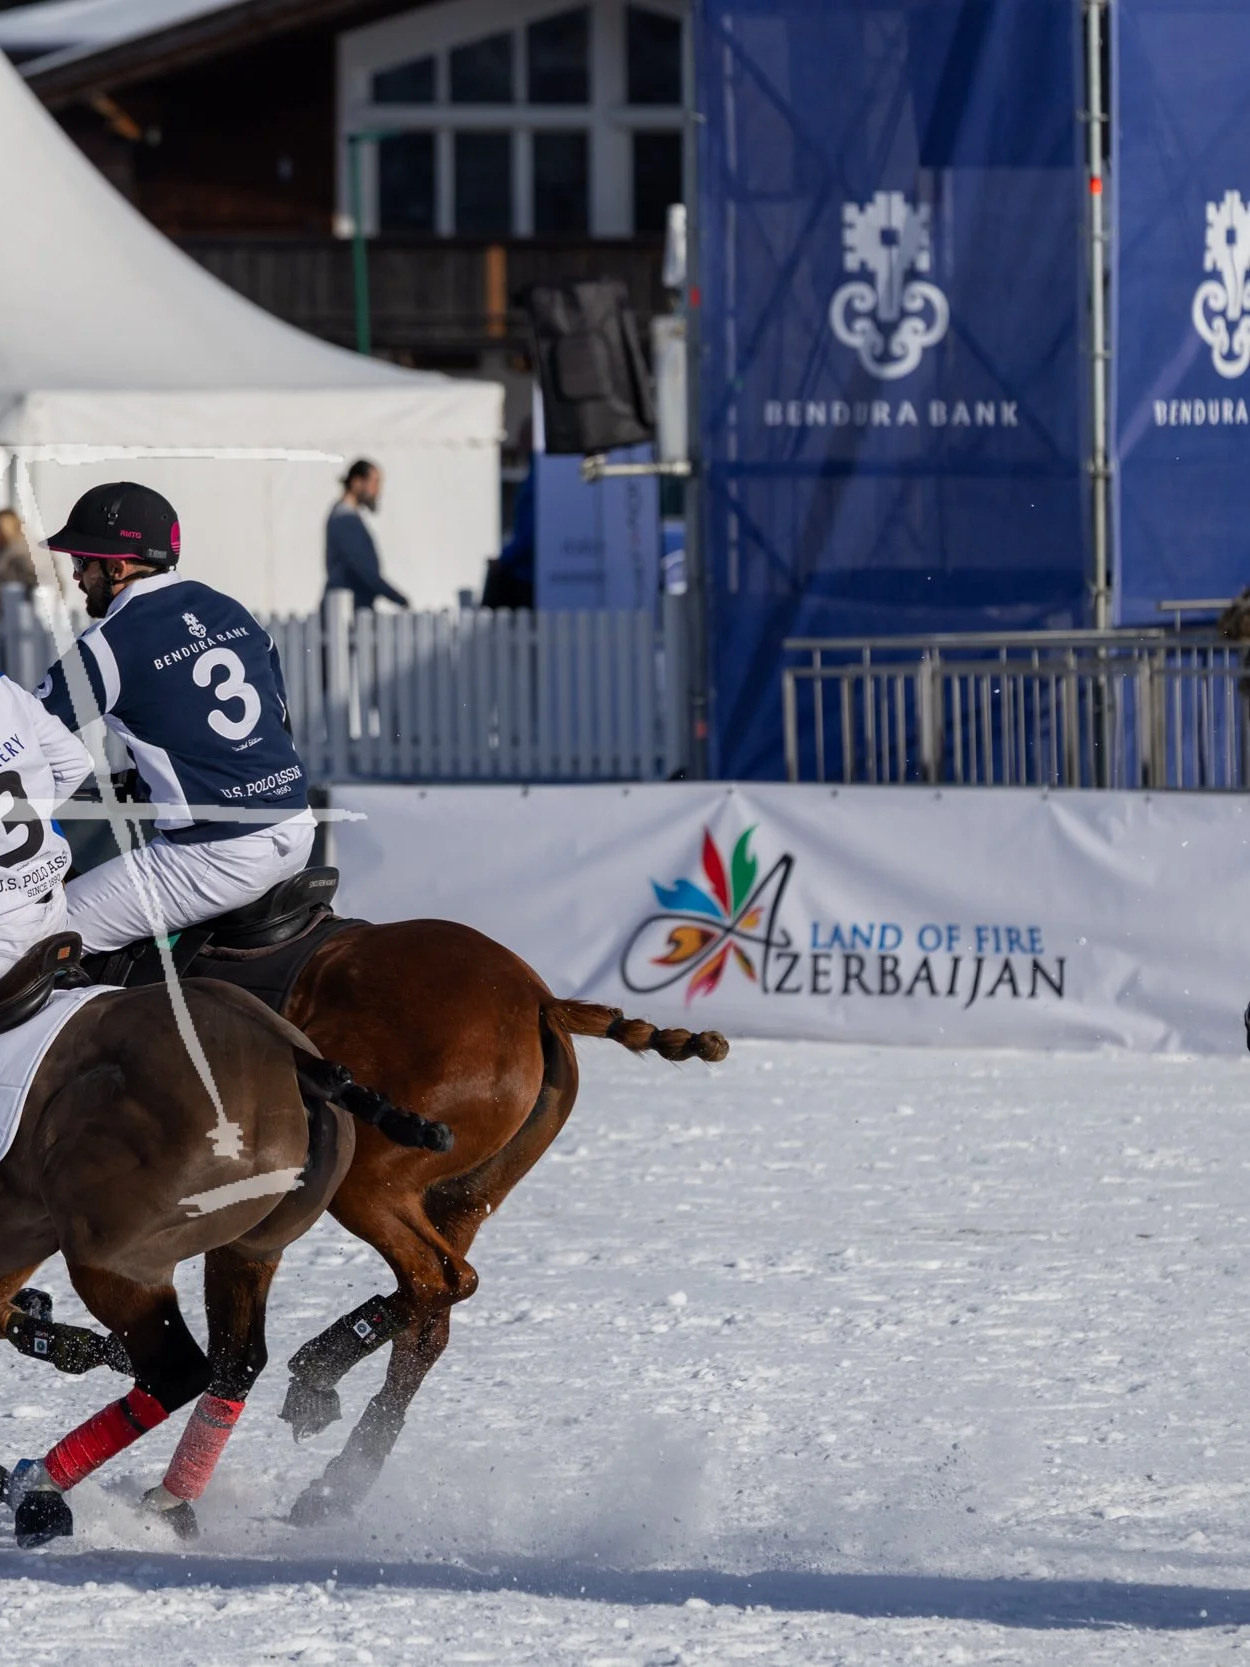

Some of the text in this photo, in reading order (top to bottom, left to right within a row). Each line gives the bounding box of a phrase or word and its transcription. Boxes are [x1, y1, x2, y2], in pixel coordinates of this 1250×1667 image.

[763, 400, 1019, 427] BENDURA BANK
[1153, 397, 1249, 427] BENDURA
[153, 626, 250, 670] BENDURA BANK
[193, 647, 261, 740] 3
[220, 786, 246, 798] U.S.
[246, 775, 275, 797] POLO
[23, 866, 49, 888] POLO
[27, 883, 49, 898] SINCE
[809, 921, 1045, 955] LAND OF FIRE
